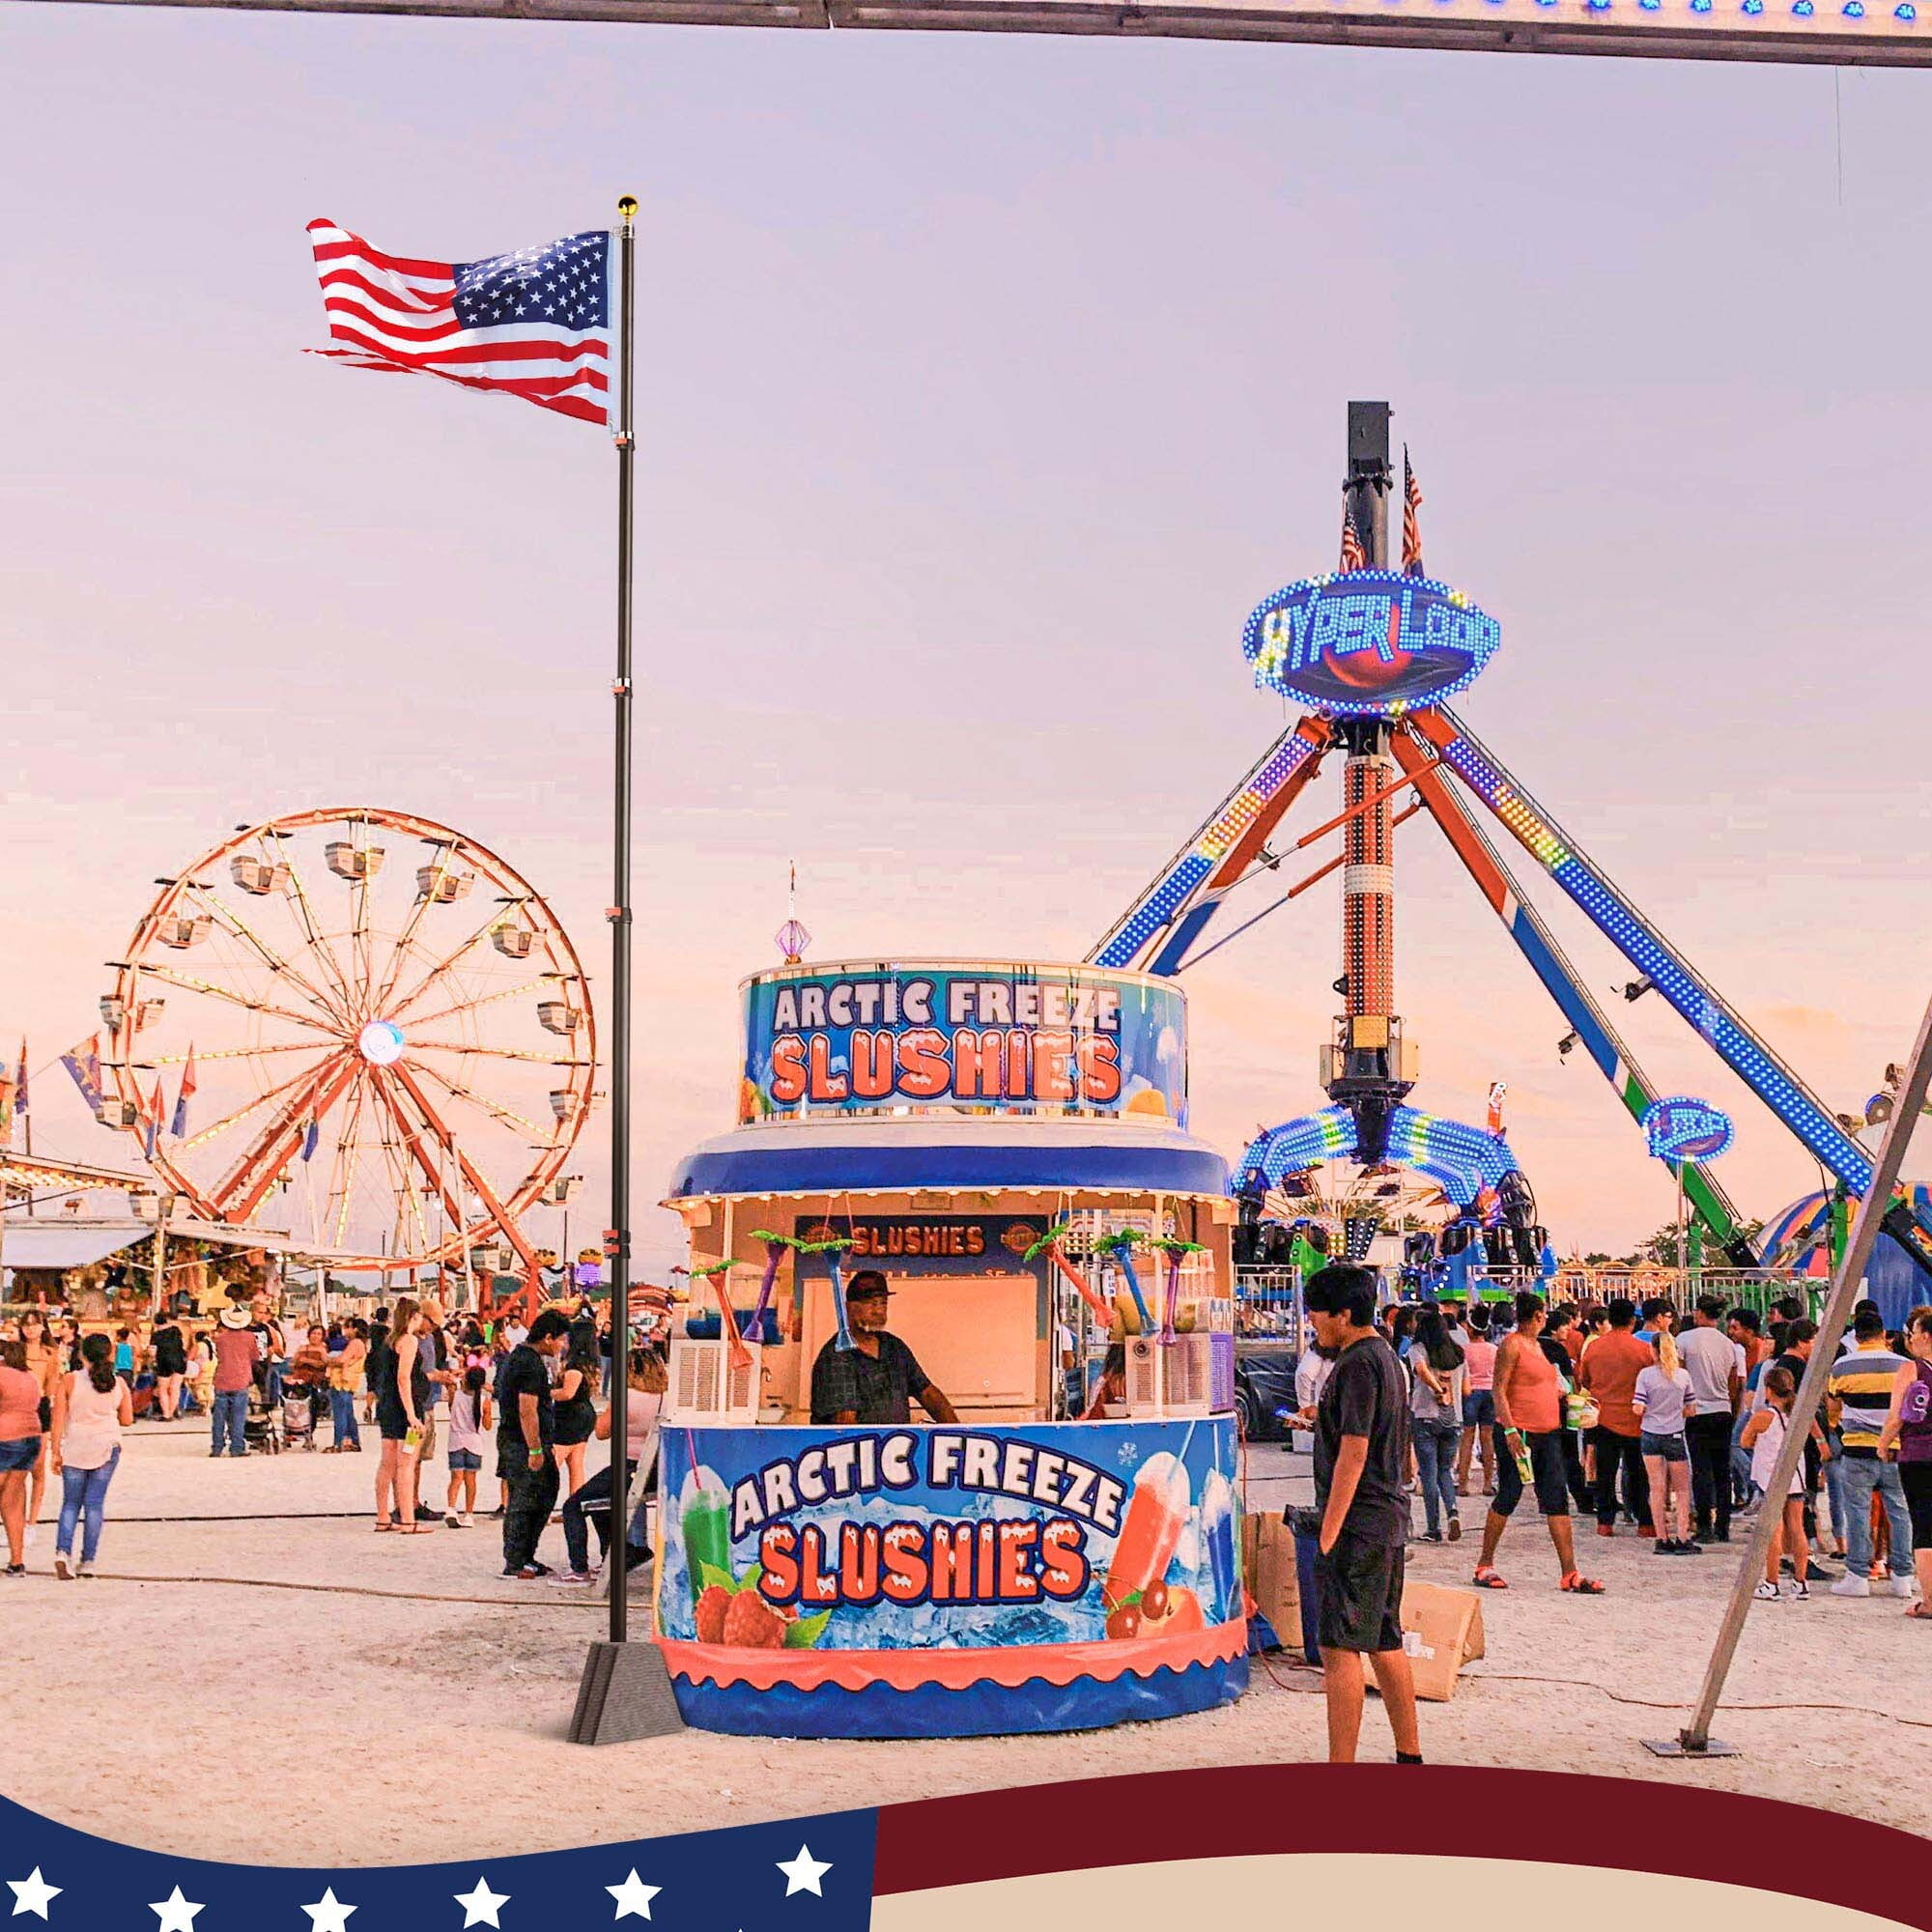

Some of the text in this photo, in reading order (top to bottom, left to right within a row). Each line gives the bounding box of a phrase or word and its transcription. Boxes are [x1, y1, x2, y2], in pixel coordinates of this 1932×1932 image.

[1256, 586, 1500, 678] HYPER LOOP
[773, 980, 1122, 1033] ARCTIC FREEZE
[770, 1028, 1122, 1103] SLUSHIES
[852, 1225, 985, 1255] SLUSHIES
[731, 1432, 1126, 1540] ARCTIC FREEZE
[759, 1520, 1088, 1605] SLUSHIES
